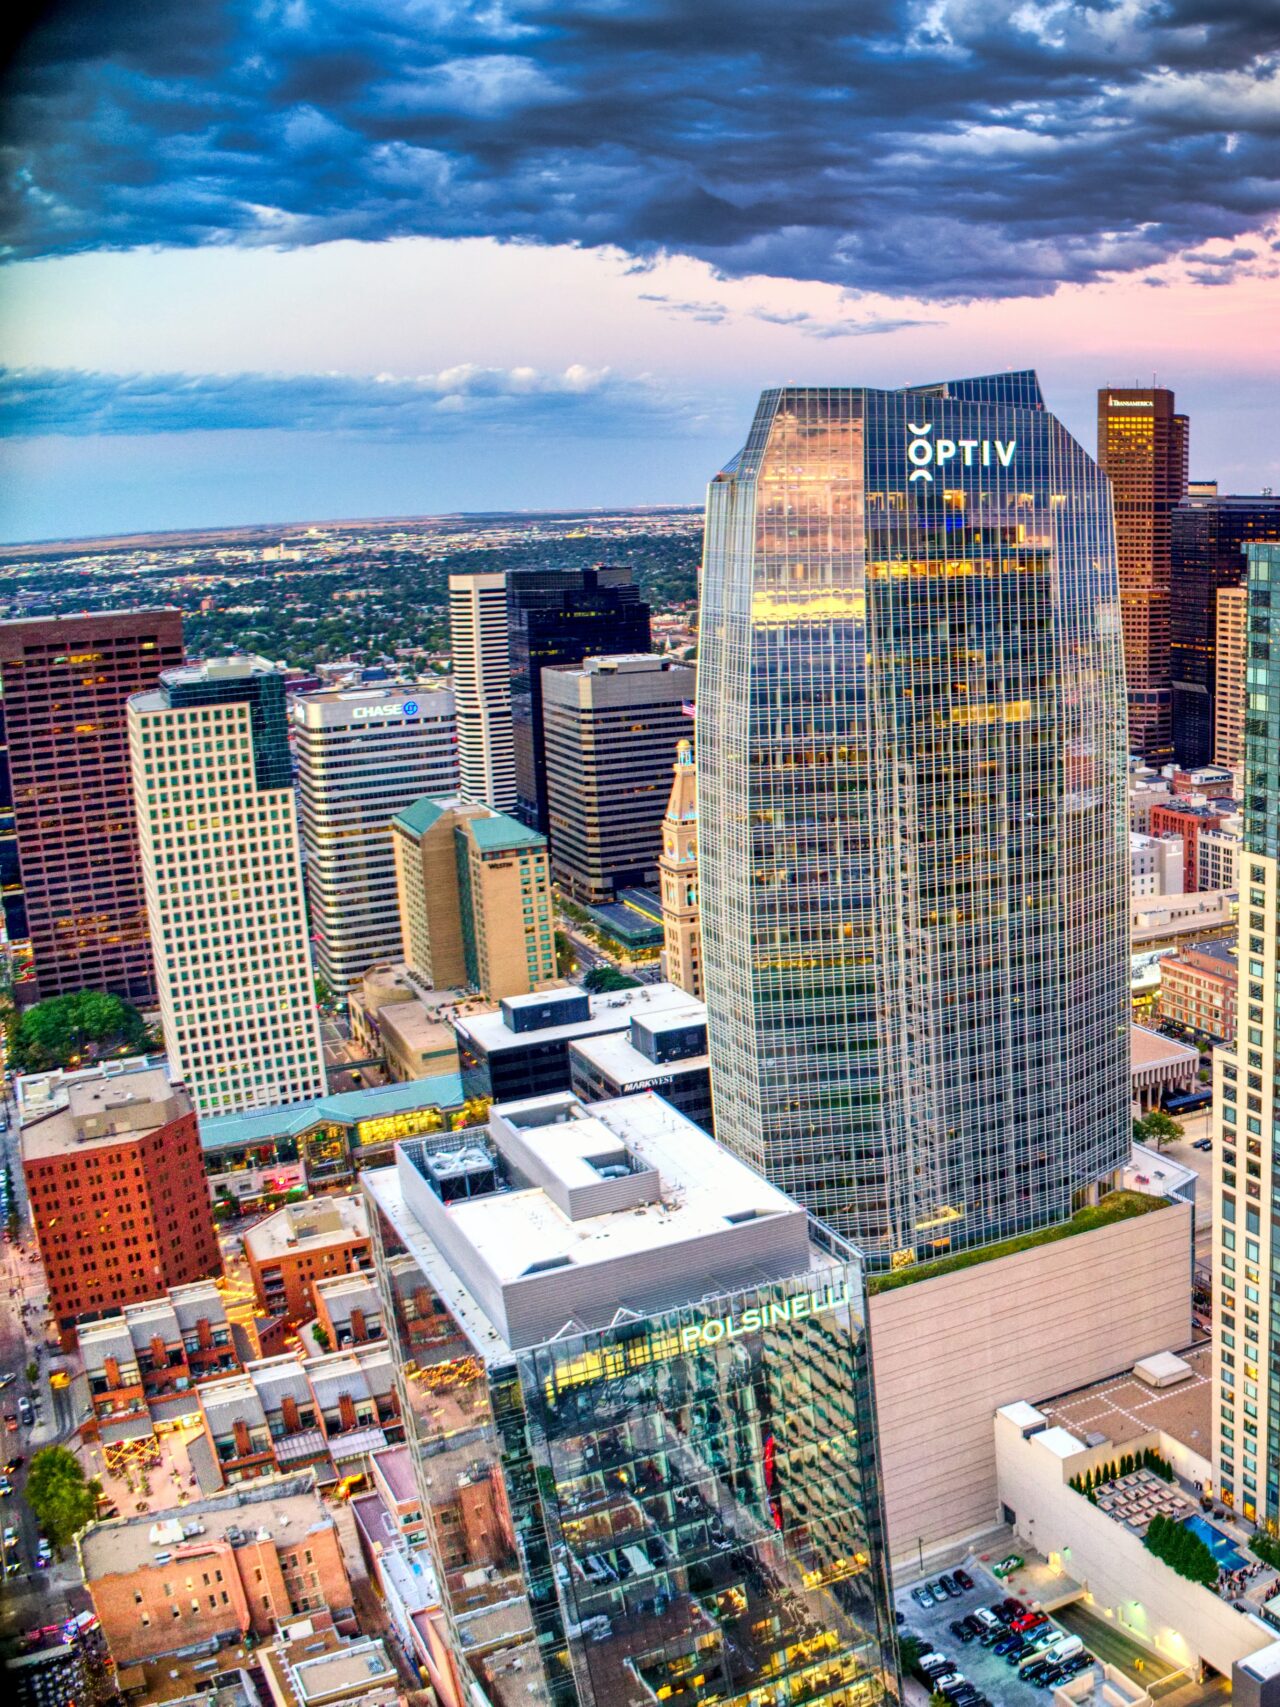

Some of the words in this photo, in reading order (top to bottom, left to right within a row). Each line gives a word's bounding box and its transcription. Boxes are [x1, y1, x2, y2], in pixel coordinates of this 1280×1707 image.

[907, 438, 1017, 467] OPTIV
[353, 703, 403, 719] CHASE
[623, 1075, 674, 1093] MARKWEST
[682, 1284, 849, 1351] POLSINELLI
